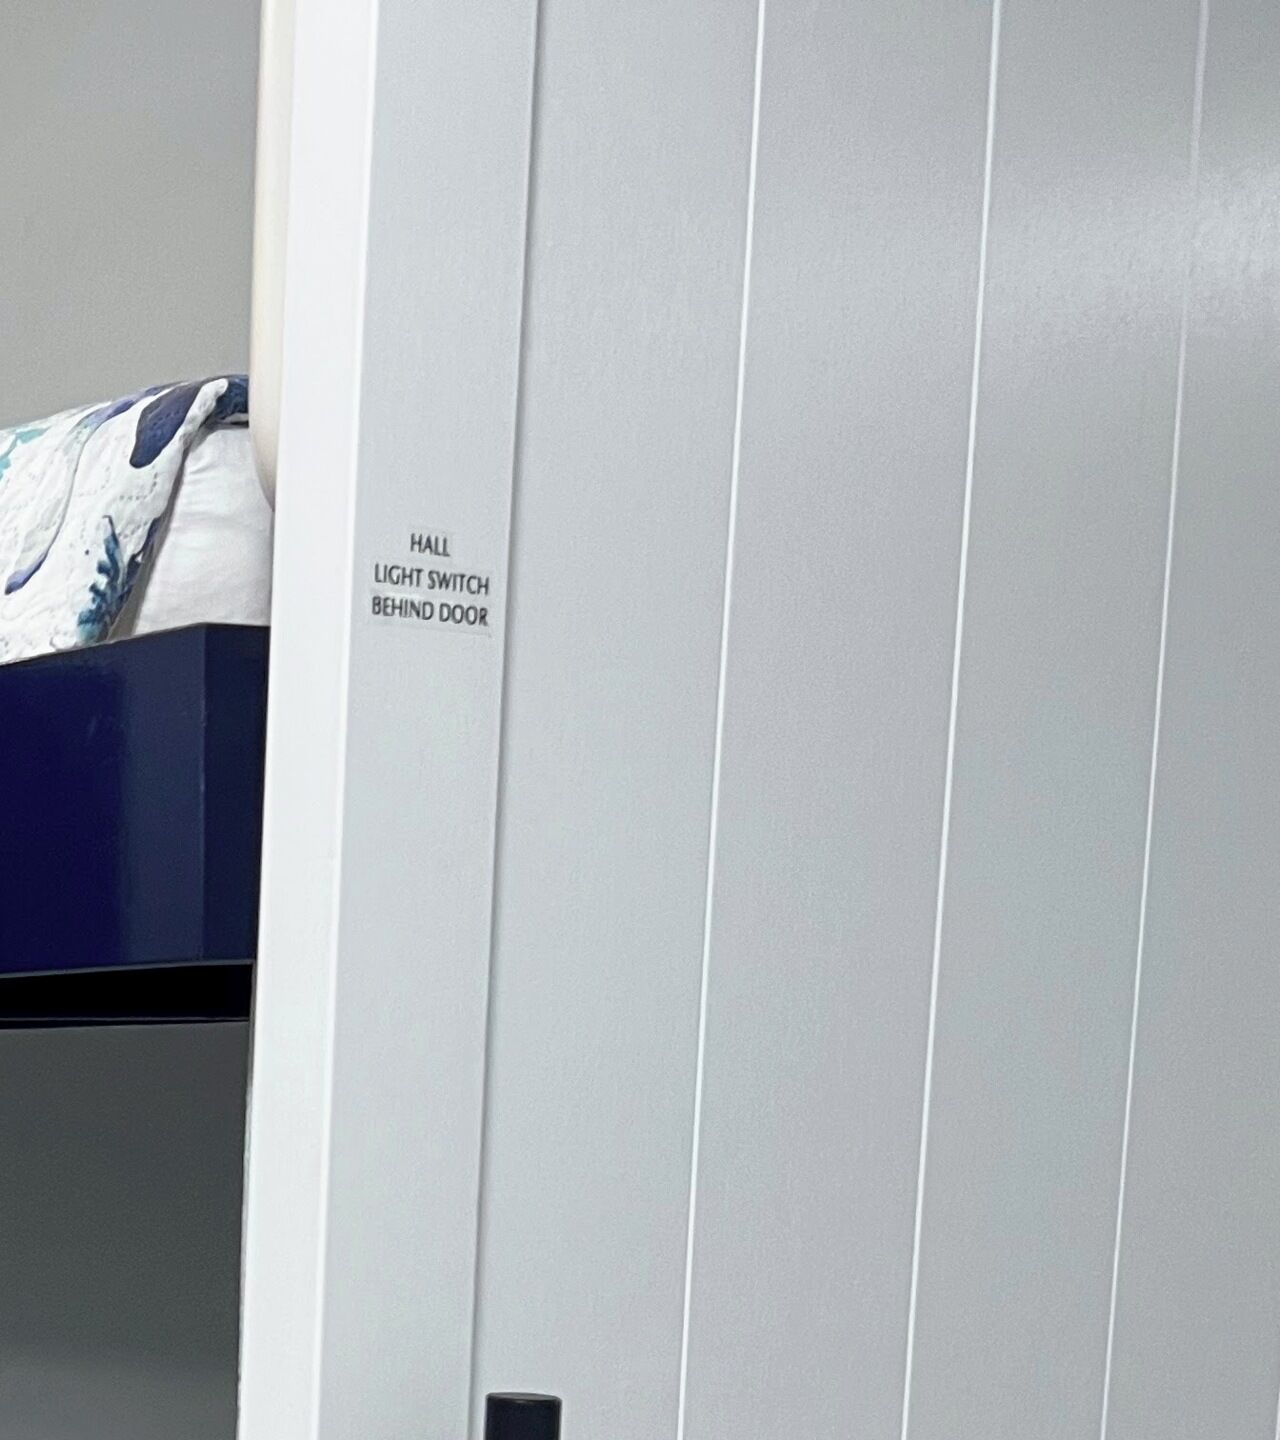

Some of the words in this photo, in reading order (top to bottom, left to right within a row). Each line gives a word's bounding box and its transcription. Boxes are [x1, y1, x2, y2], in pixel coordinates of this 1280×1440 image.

[410, 533, 450, 556] HALL
[374, 563, 424, 587] LIGHT
[427, 570, 490, 596] SWITCH
[371, 596, 434, 620] BEHIND
[439, 603, 489, 626] DOOR
